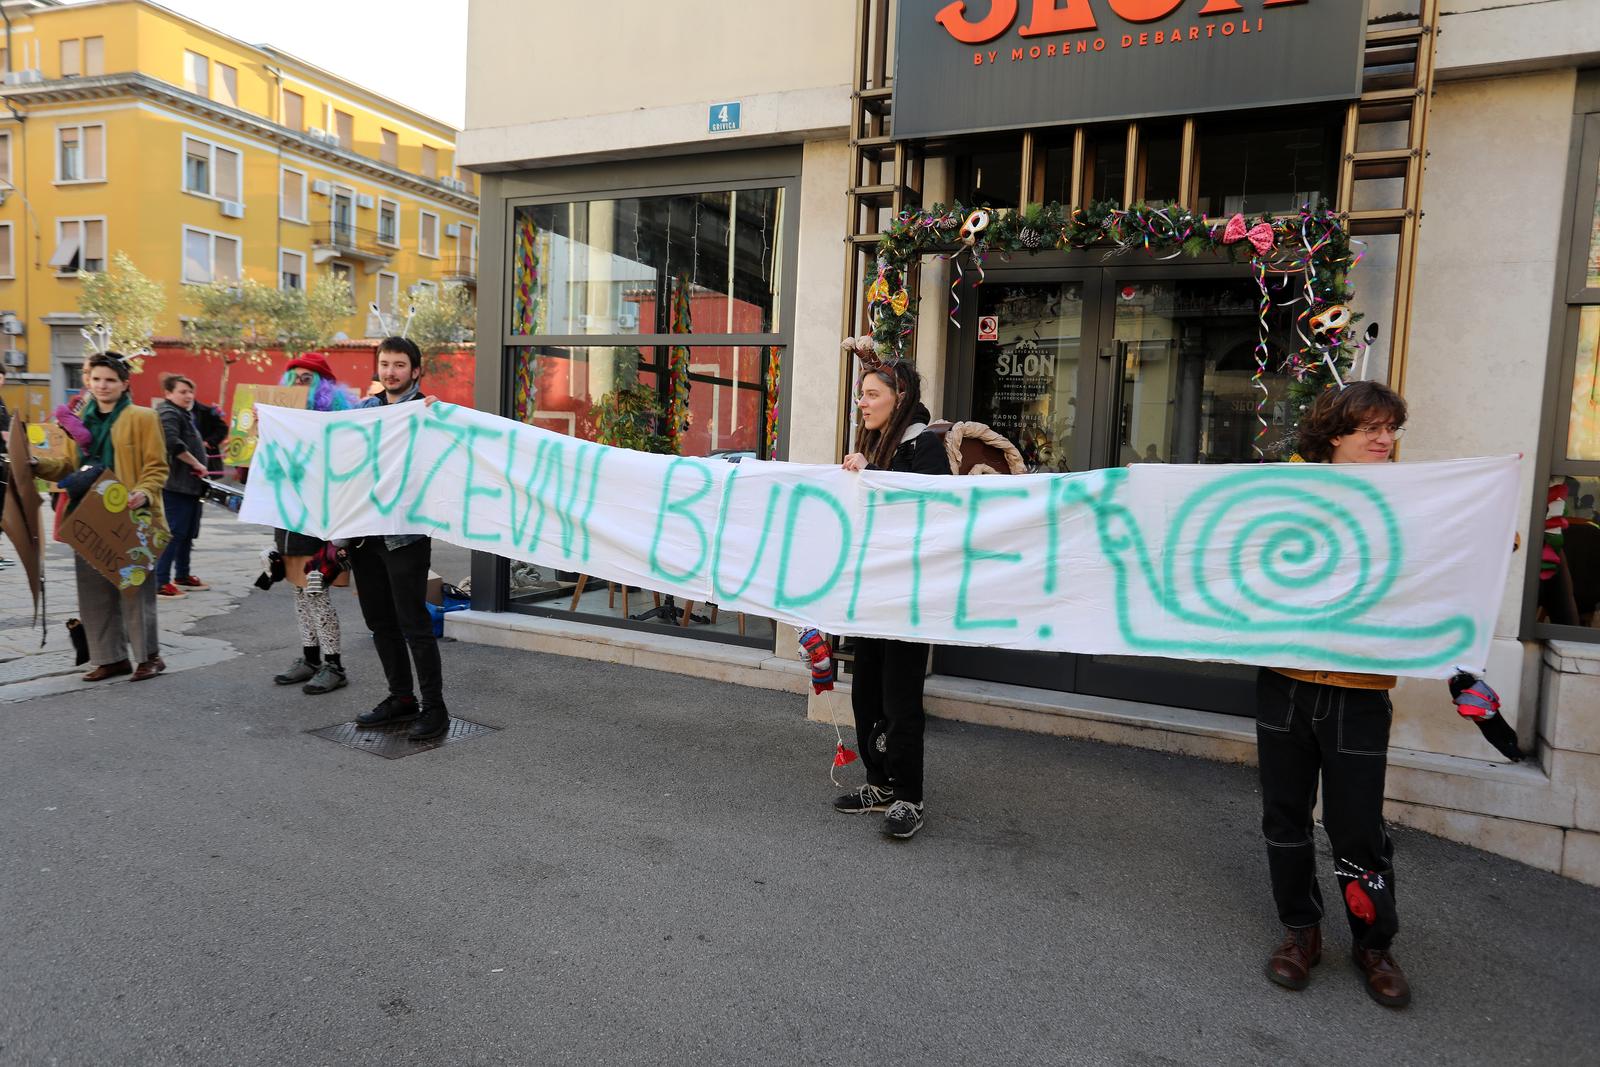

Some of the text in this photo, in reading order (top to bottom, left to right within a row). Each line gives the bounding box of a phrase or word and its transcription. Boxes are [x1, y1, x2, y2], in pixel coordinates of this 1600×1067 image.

[973, 51, 998, 65] BY
[1011, 37, 1106, 61] MORENO
[1120, 17, 1265, 49] DEBARTOLI
[718, 105, 729, 123] 4
[995, 354, 1056, 377] SLON
[320, 400, 1062, 640] PUŽEVNI BUDITE!
